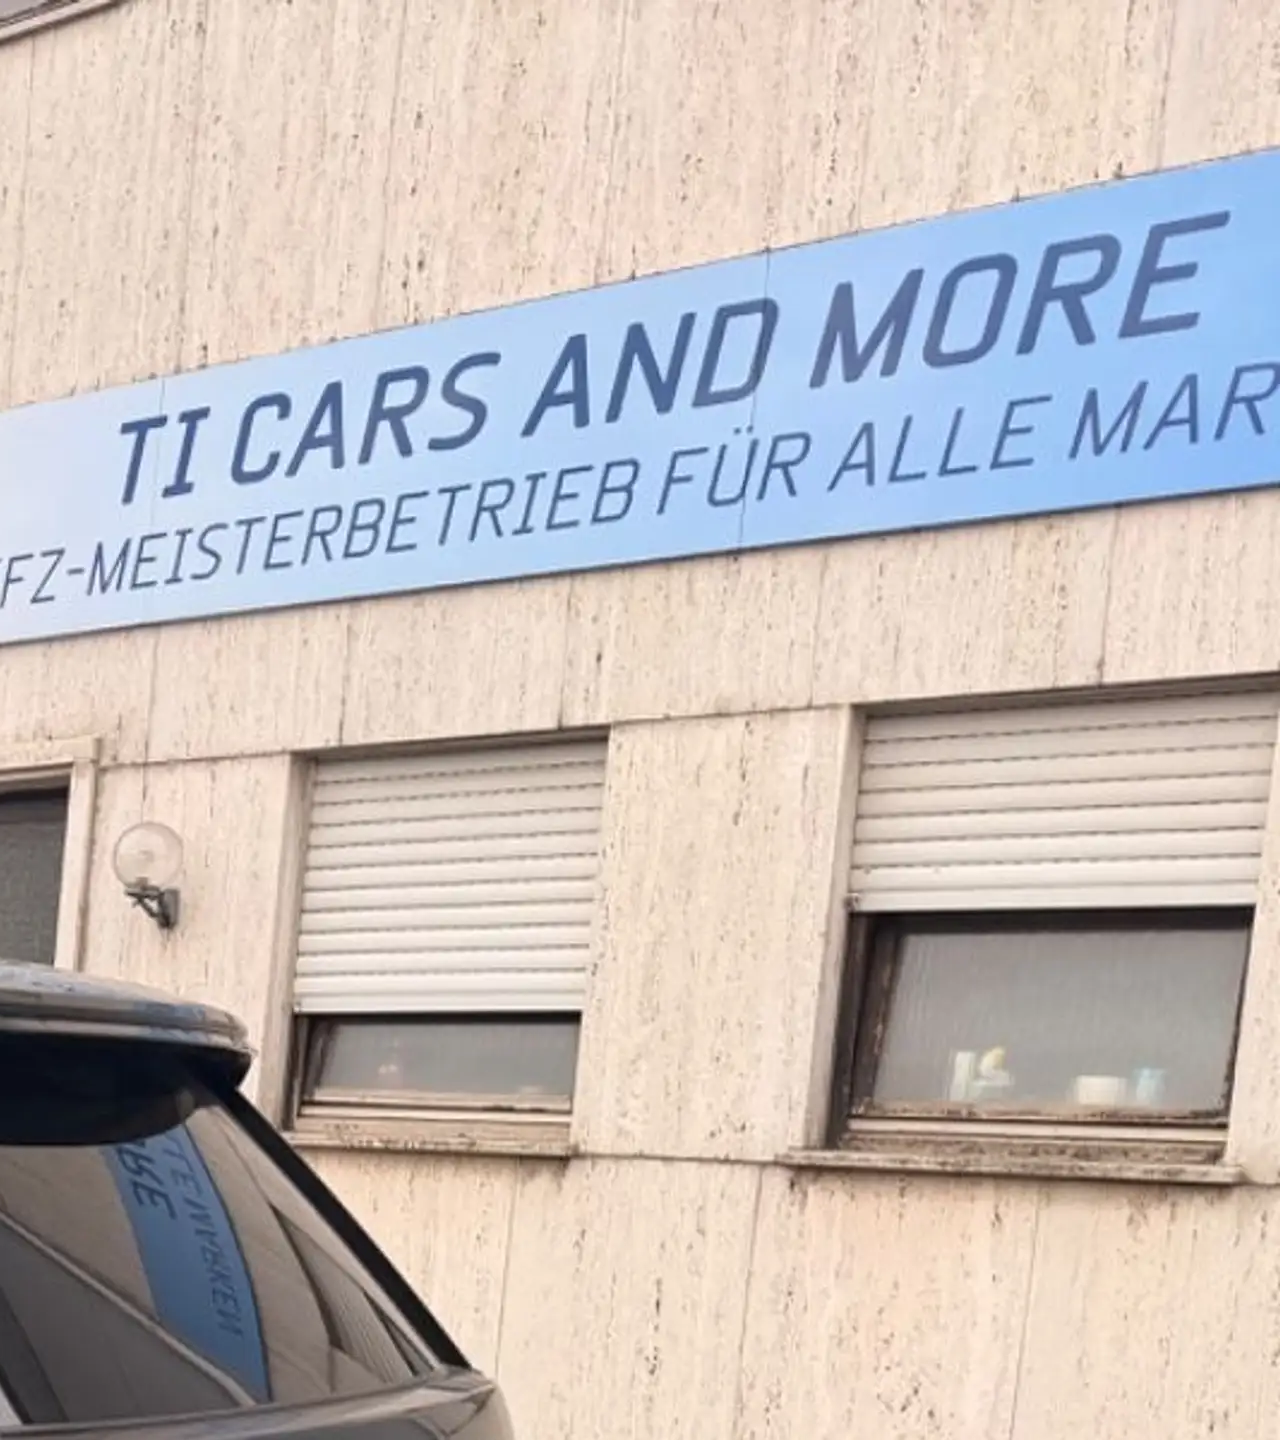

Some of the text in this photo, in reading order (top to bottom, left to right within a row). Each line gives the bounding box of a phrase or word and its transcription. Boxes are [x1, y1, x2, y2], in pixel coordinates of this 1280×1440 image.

[119, 210, 1231, 505] TI CARS AND MORE
[656, 426, 812, 515] FÜR
[827, 395, 1052, 491] ALLE
